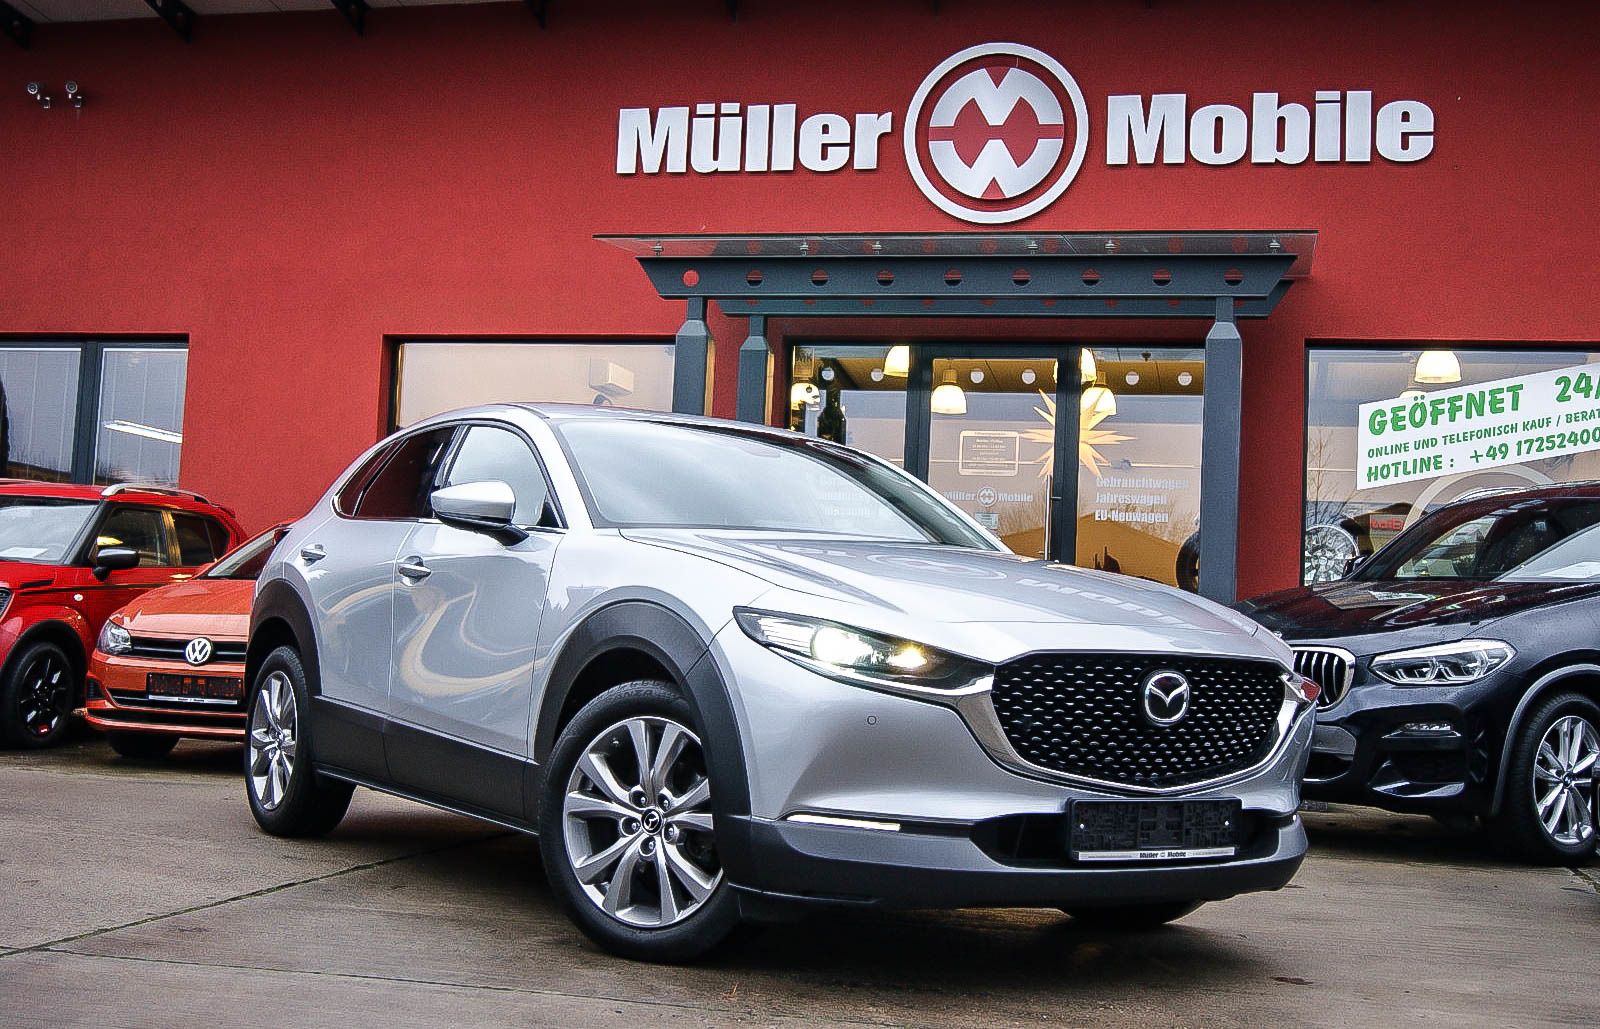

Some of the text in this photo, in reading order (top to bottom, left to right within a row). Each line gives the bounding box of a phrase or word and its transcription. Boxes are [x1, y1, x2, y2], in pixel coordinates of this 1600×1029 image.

[616, 102, 892, 176] Müller
[1106, 90, 1435, 167] Mobile
[1368, 384, 1524, 436] GEÖFFNET
[1367, 442, 1410, 458] ONLINE
[1413, 437, 1438, 450] UND
[1442, 422, 1518, 446] TELEFONISCH
[1522, 417, 1552, 432] KAUF
[1367, 454, 1443, 483] HOTLINE
[1469, 442, 1509, 464] +49
[997, 492, 1033, 503] Mobile
[1095, 509, 1169, 523] EU-Neuwagen
[1096, 492, 1168, 505] Jahreswagen
